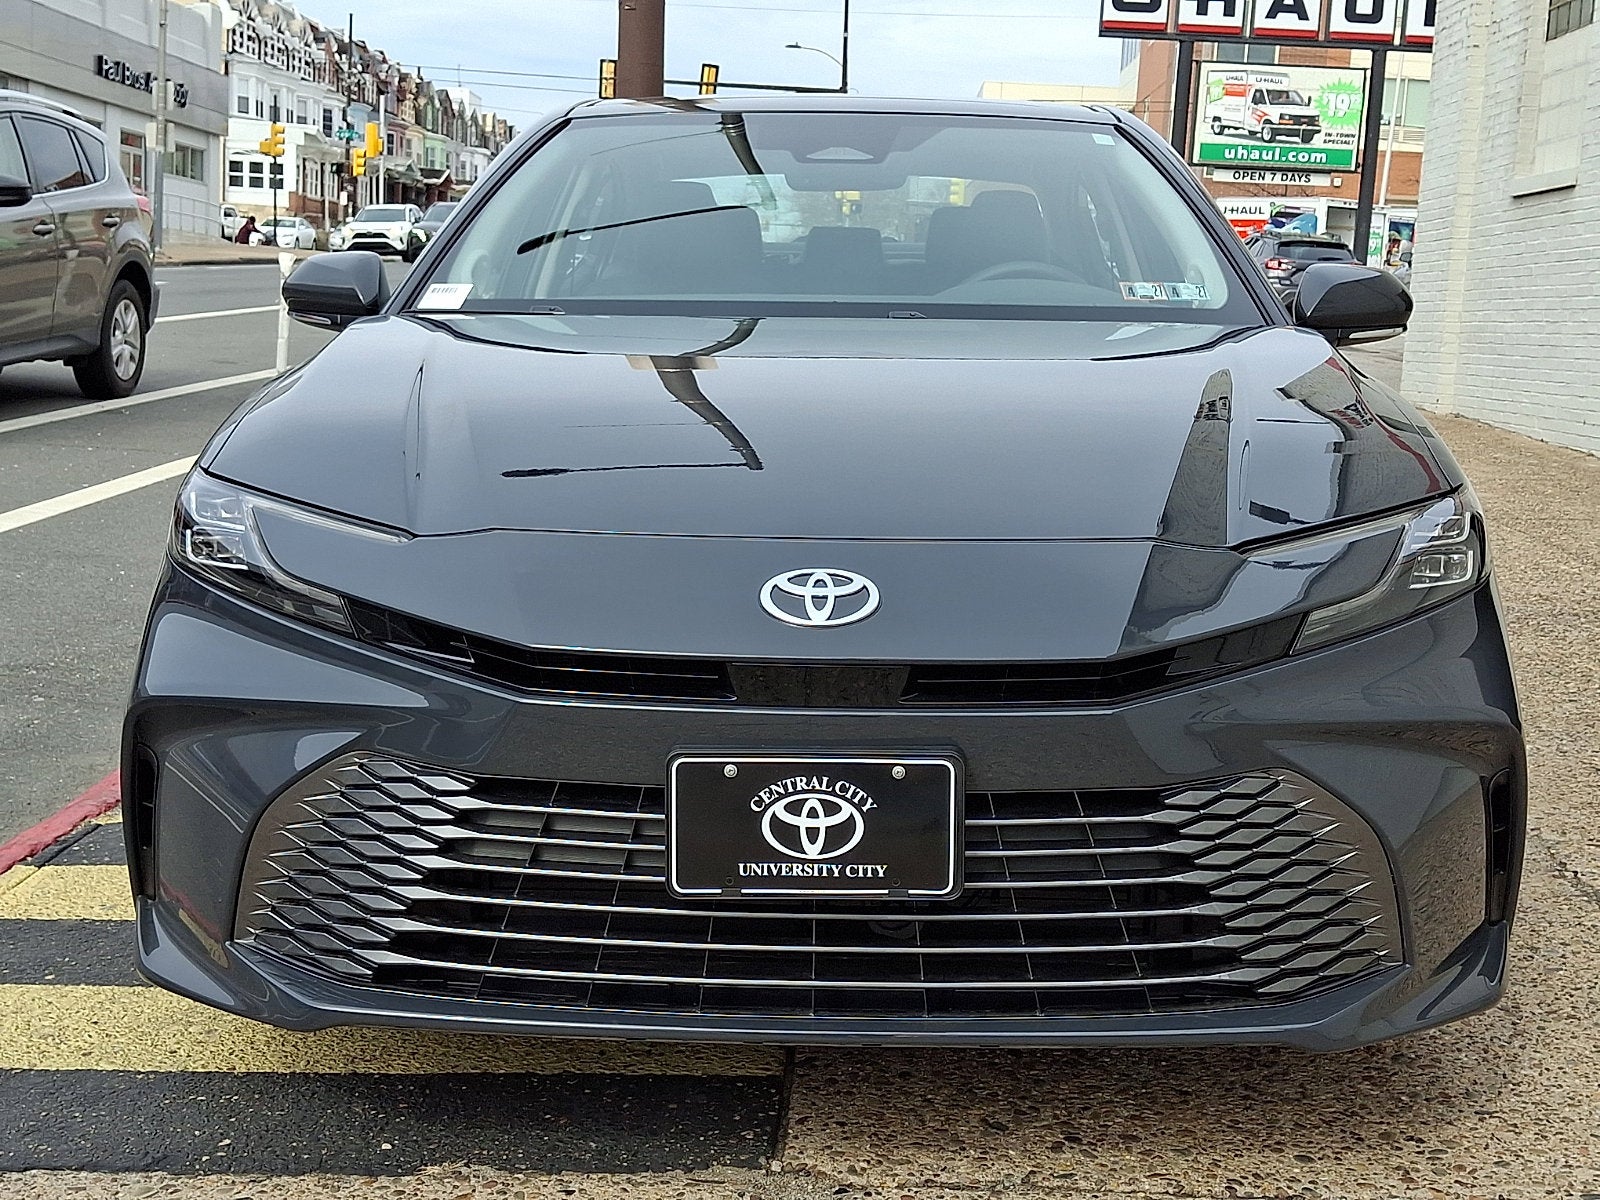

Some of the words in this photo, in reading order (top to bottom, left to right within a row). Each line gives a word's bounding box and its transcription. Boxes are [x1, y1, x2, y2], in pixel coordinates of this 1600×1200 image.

[1224, 147, 1327, 163] uhaul.com
[1233, 170, 1266, 181] OPEN
[1270, 172, 1277, 182] 7
[1280, 173, 1312, 183] DAYS
[750, 775, 833, 812] CENTRAL
[834, 780, 878, 813] CITY
[738, 862, 843, 878] UNIVERSITY
[845, 864, 888, 878] CITY
